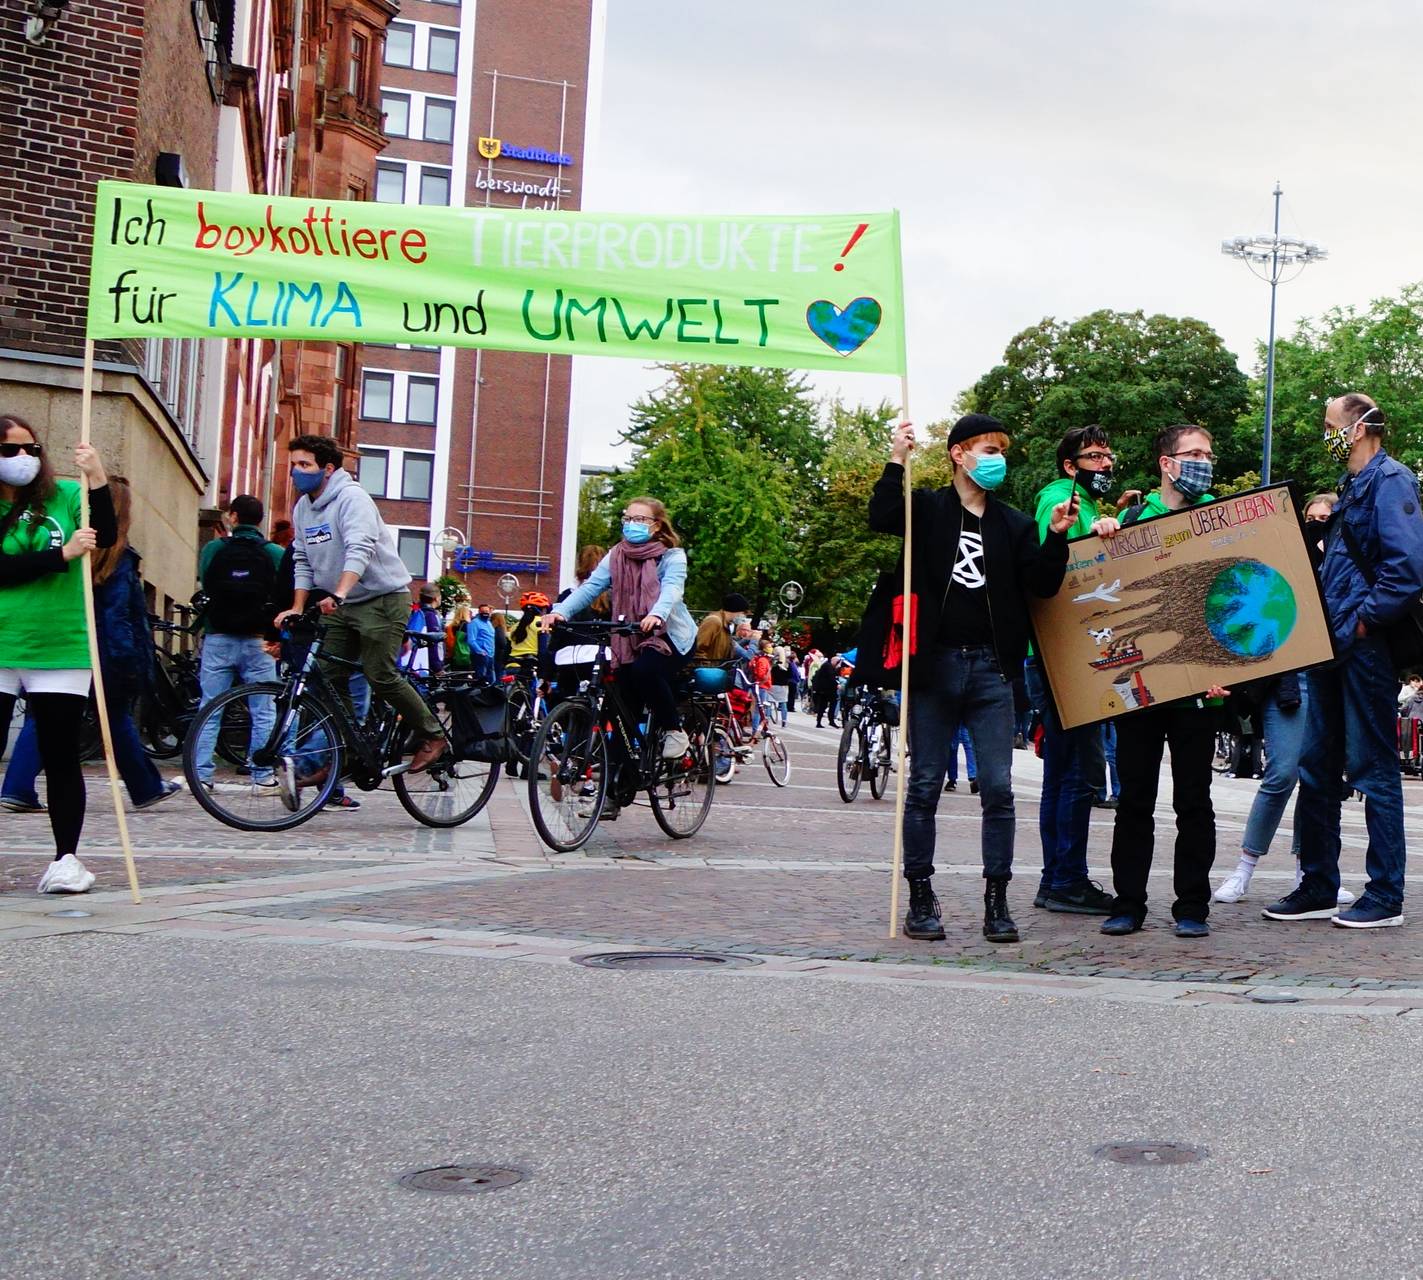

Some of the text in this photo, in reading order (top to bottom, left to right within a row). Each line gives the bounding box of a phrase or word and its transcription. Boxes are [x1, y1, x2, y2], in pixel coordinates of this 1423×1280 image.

[501, 143, 572, 166] Stadthaus
[110, 197, 167, 246] Ich
[195, 201, 427, 264] boykottiere
[108, 270, 780, 347] für KLIMA und UMWELT
[1163, 527, 1193, 548] zum
[1154, 551, 1172, 562] oder
